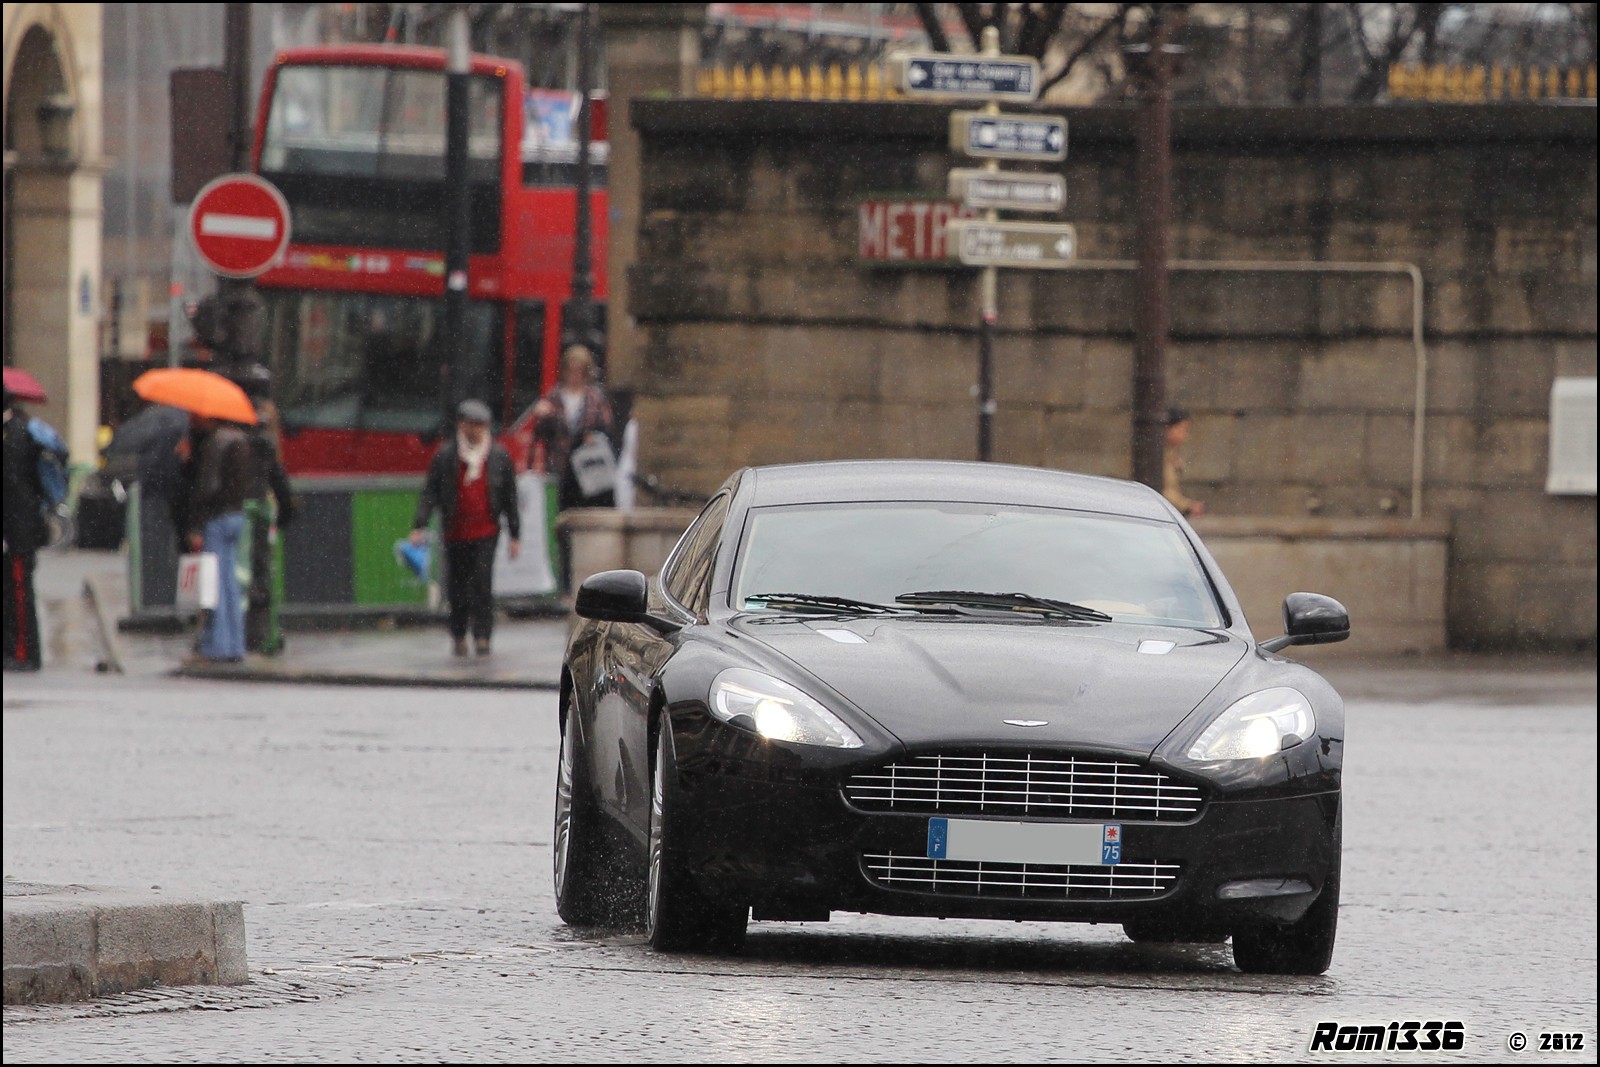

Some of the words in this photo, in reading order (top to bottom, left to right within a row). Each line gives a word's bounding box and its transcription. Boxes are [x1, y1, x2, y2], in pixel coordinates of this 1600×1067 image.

[860, 201, 974, 259] METR
[934, 843, 941, 852] F
[1103, 845, 1120, 860] 75
